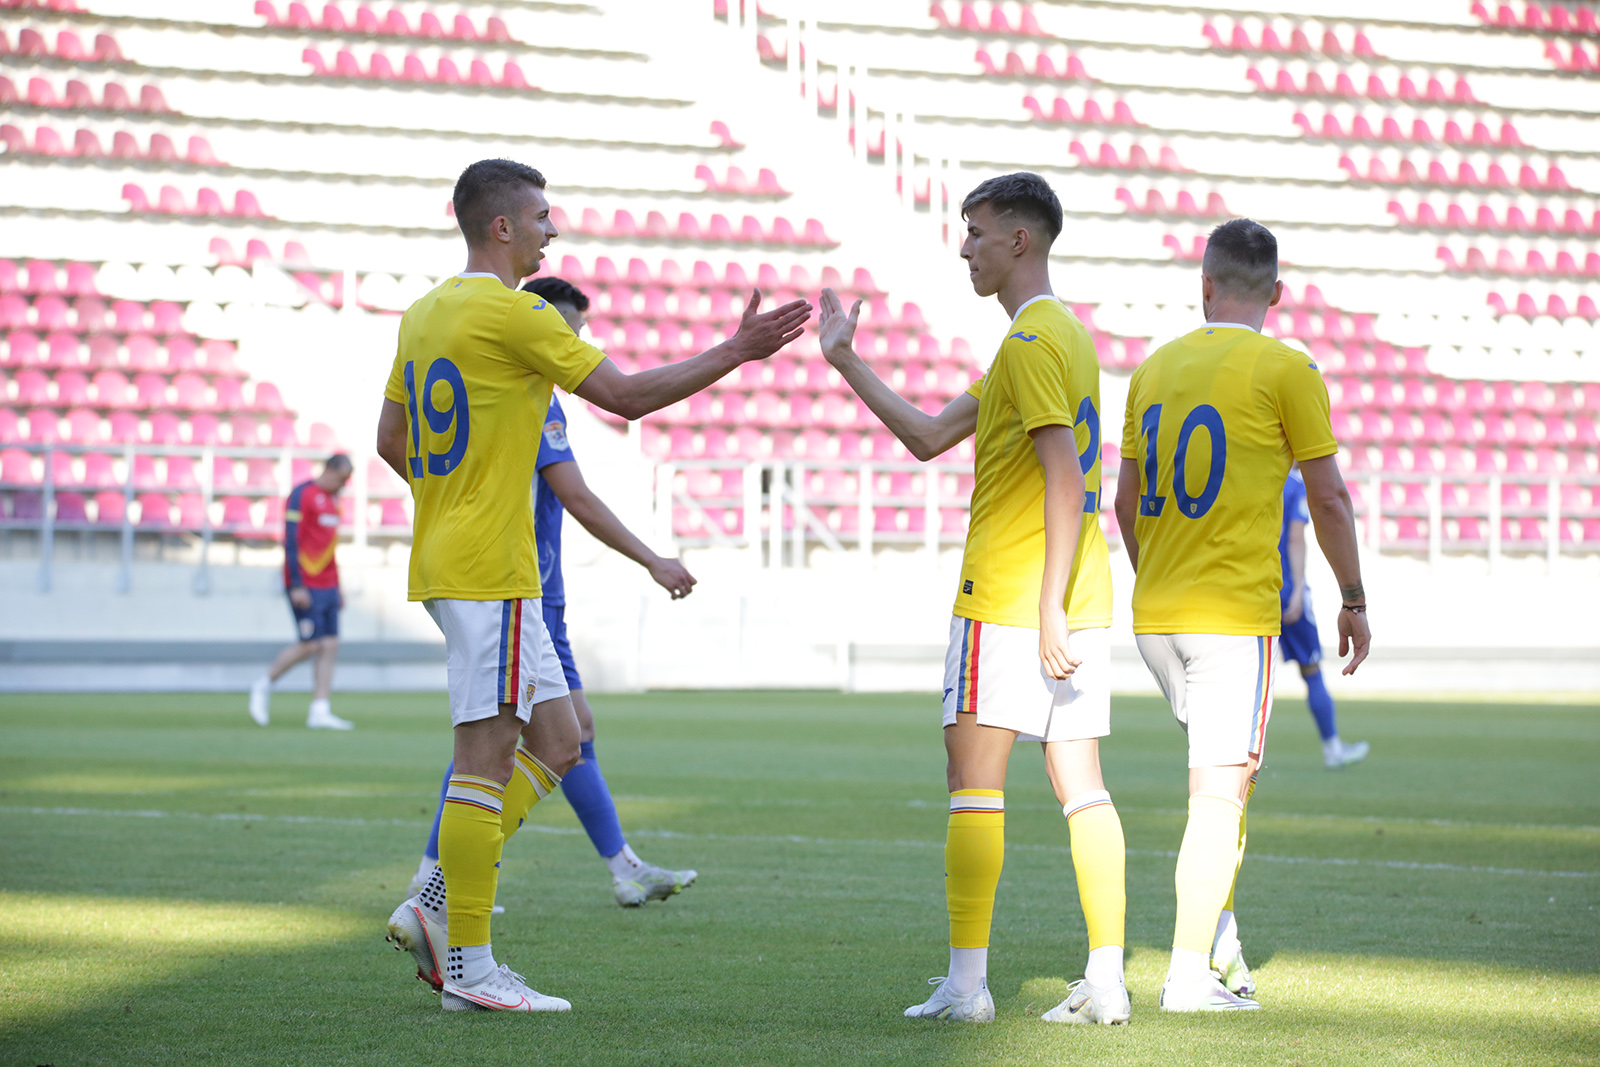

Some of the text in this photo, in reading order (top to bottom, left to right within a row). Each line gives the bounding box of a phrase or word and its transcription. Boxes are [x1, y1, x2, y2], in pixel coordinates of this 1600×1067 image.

[404, 357, 470, 478] 19
[1074, 395, 1102, 514] 2
[1140, 403, 1227, 519] 10
